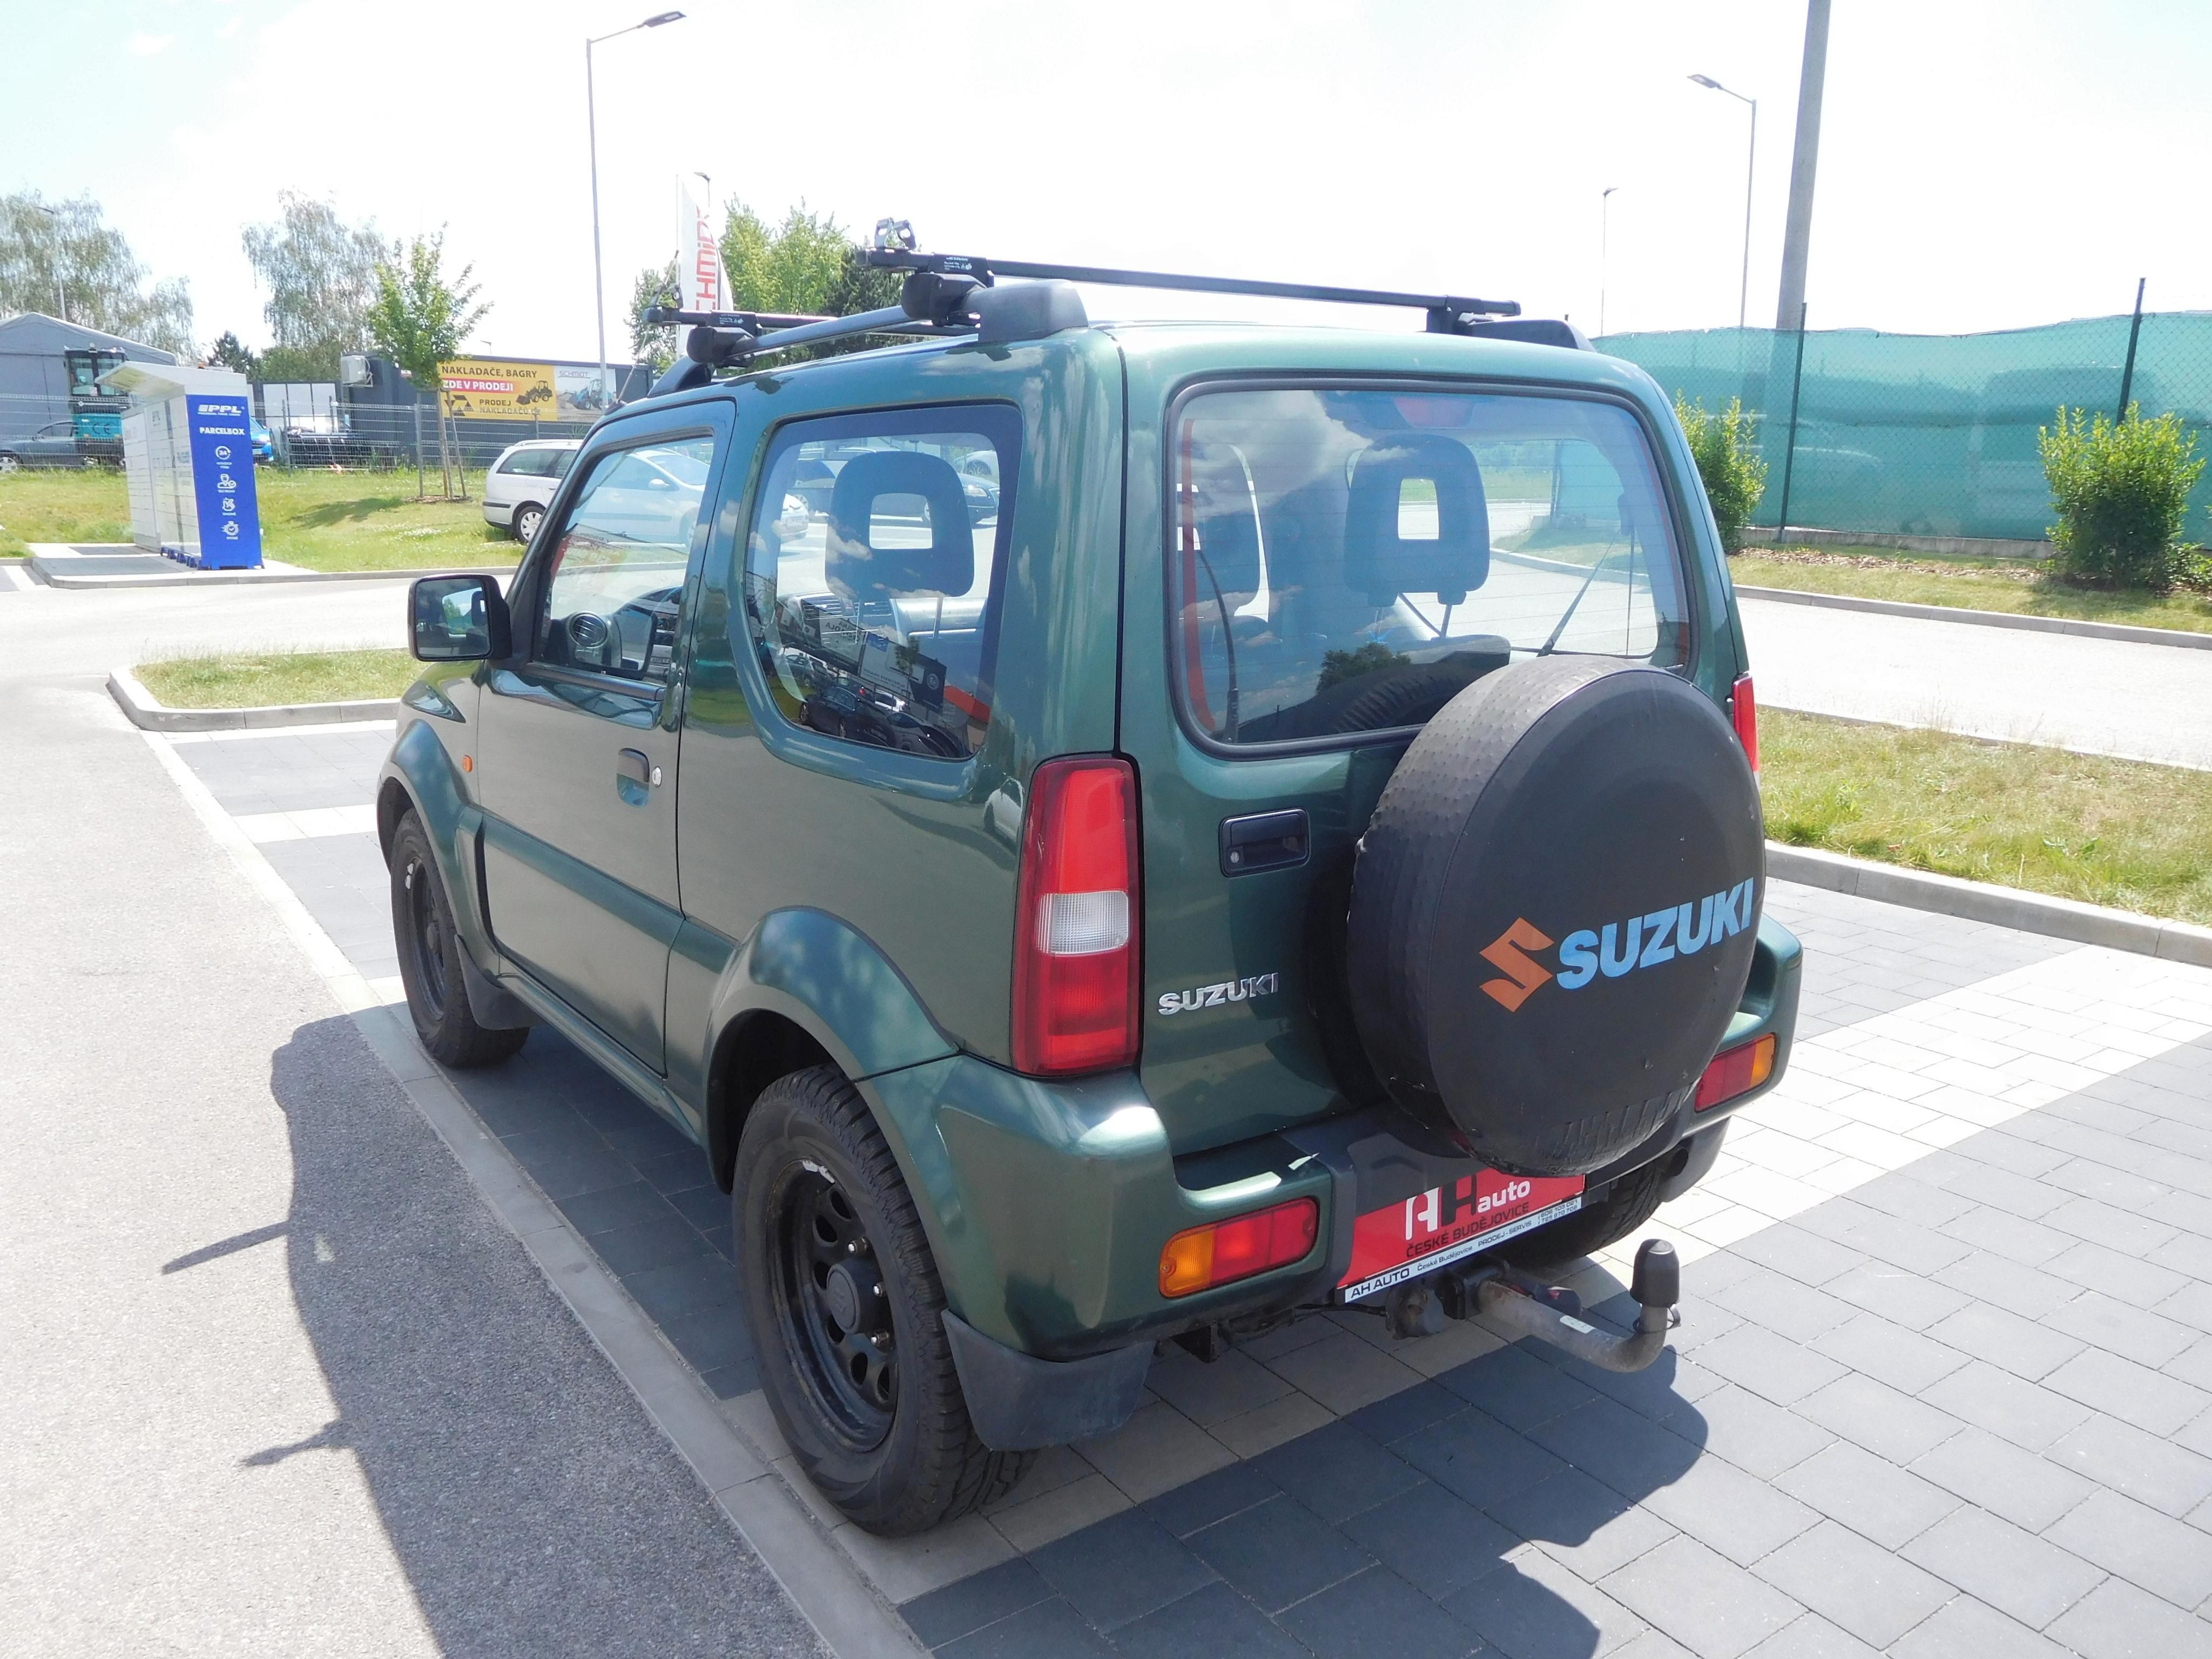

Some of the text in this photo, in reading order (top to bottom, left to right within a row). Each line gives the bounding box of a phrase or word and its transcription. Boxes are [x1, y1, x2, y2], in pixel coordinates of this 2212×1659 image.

[442, 366, 537, 378] NAKLADAČE, BAGRY
[463, 381, 470, 389] V
[473, 382, 513, 391] PRODEJI
[208, 405, 241, 413] PPL
[199, 427, 245, 435] PARCELBOX
[1557, 877, 1754, 989] SUZUKI
[1158, 973, 1278, 1015] SUZUKI
[1478, 1181, 1530, 1213] auto
[1406, 1202, 1529, 1257] ČESKÉ BUDĚJOVICE
[1351, 1283, 1370, 1298] AH
[1373, 1268, 1410, 1289] AUTO
[1417, 1258, 1438, 1271] České
[1439, 1245, 1473, 1263] Budějovice
